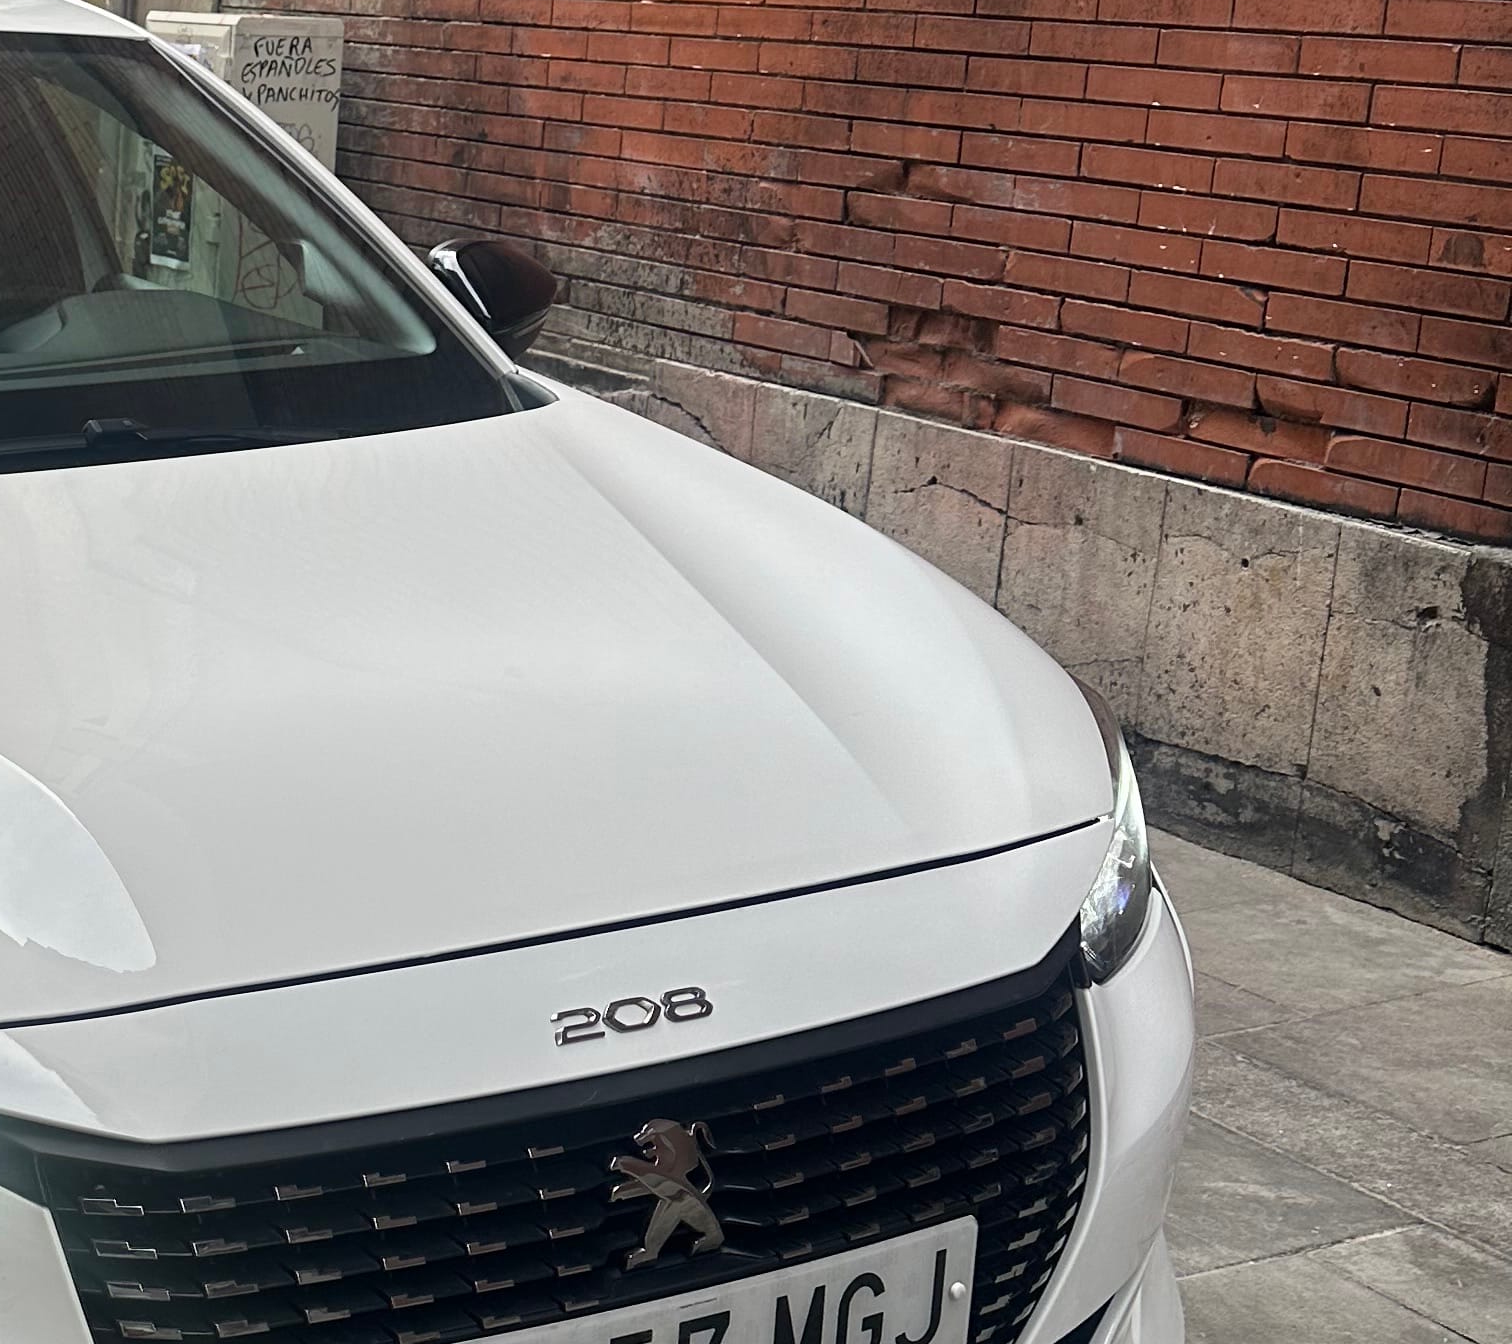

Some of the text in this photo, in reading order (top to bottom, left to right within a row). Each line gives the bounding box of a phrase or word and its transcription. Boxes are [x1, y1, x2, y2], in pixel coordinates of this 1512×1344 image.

[254, 36, 313, 58] FUERA
[241, 55, 337, 83] ESPAÑOLES
[550, 986, 714, 1046] 208
